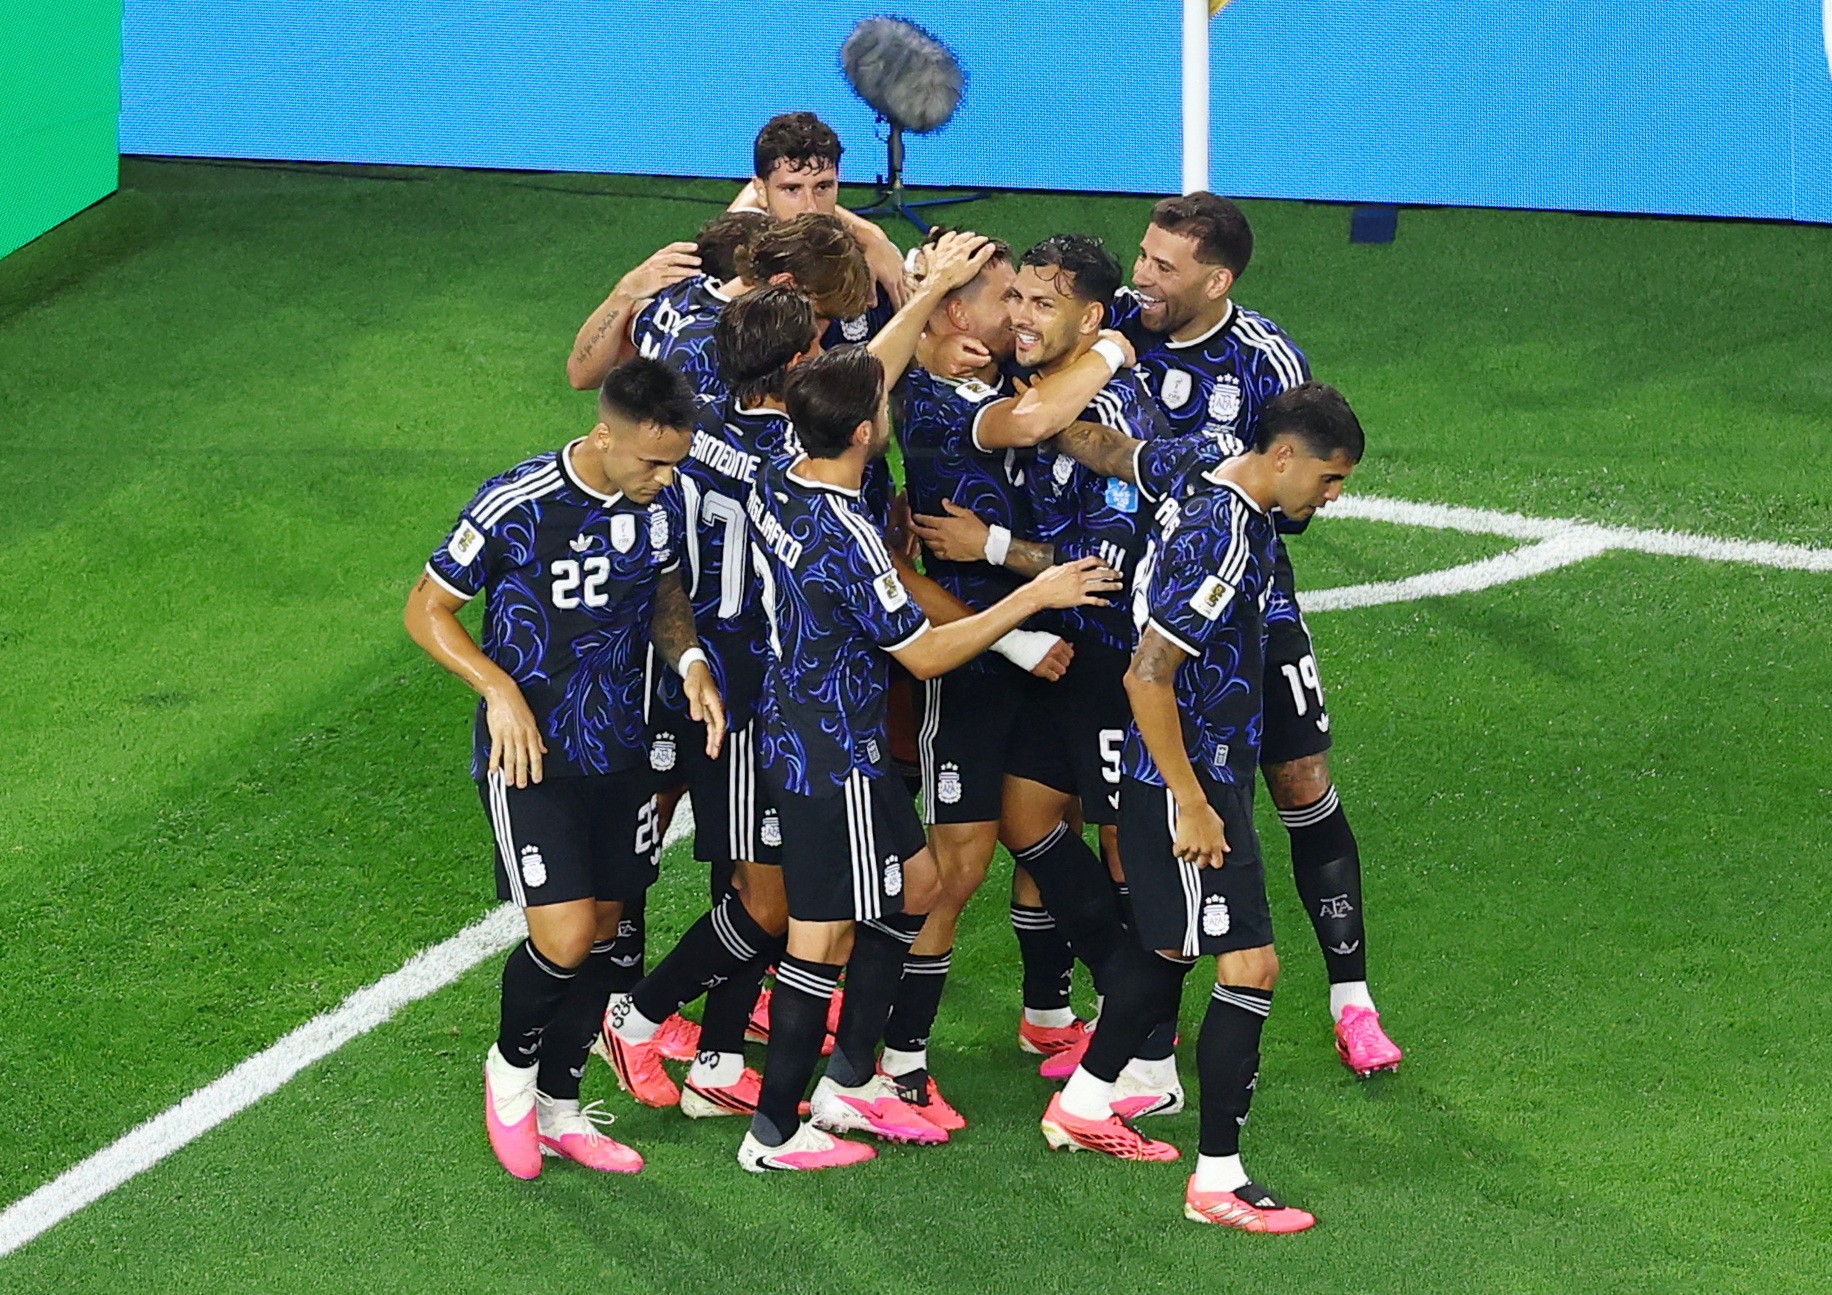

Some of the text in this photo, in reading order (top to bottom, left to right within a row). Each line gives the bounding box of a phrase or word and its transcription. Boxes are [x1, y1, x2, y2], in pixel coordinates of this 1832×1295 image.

[689, 429, 762, 484] SIMEONE
[747, 482, 803, 570] GLIAFICO
[551, 556, 611, 609] 22
[1281, 654, 1324, 717] 19
[1099, 729, 1124, 783] 5
[1320, 893, 1354, 919] AFA
